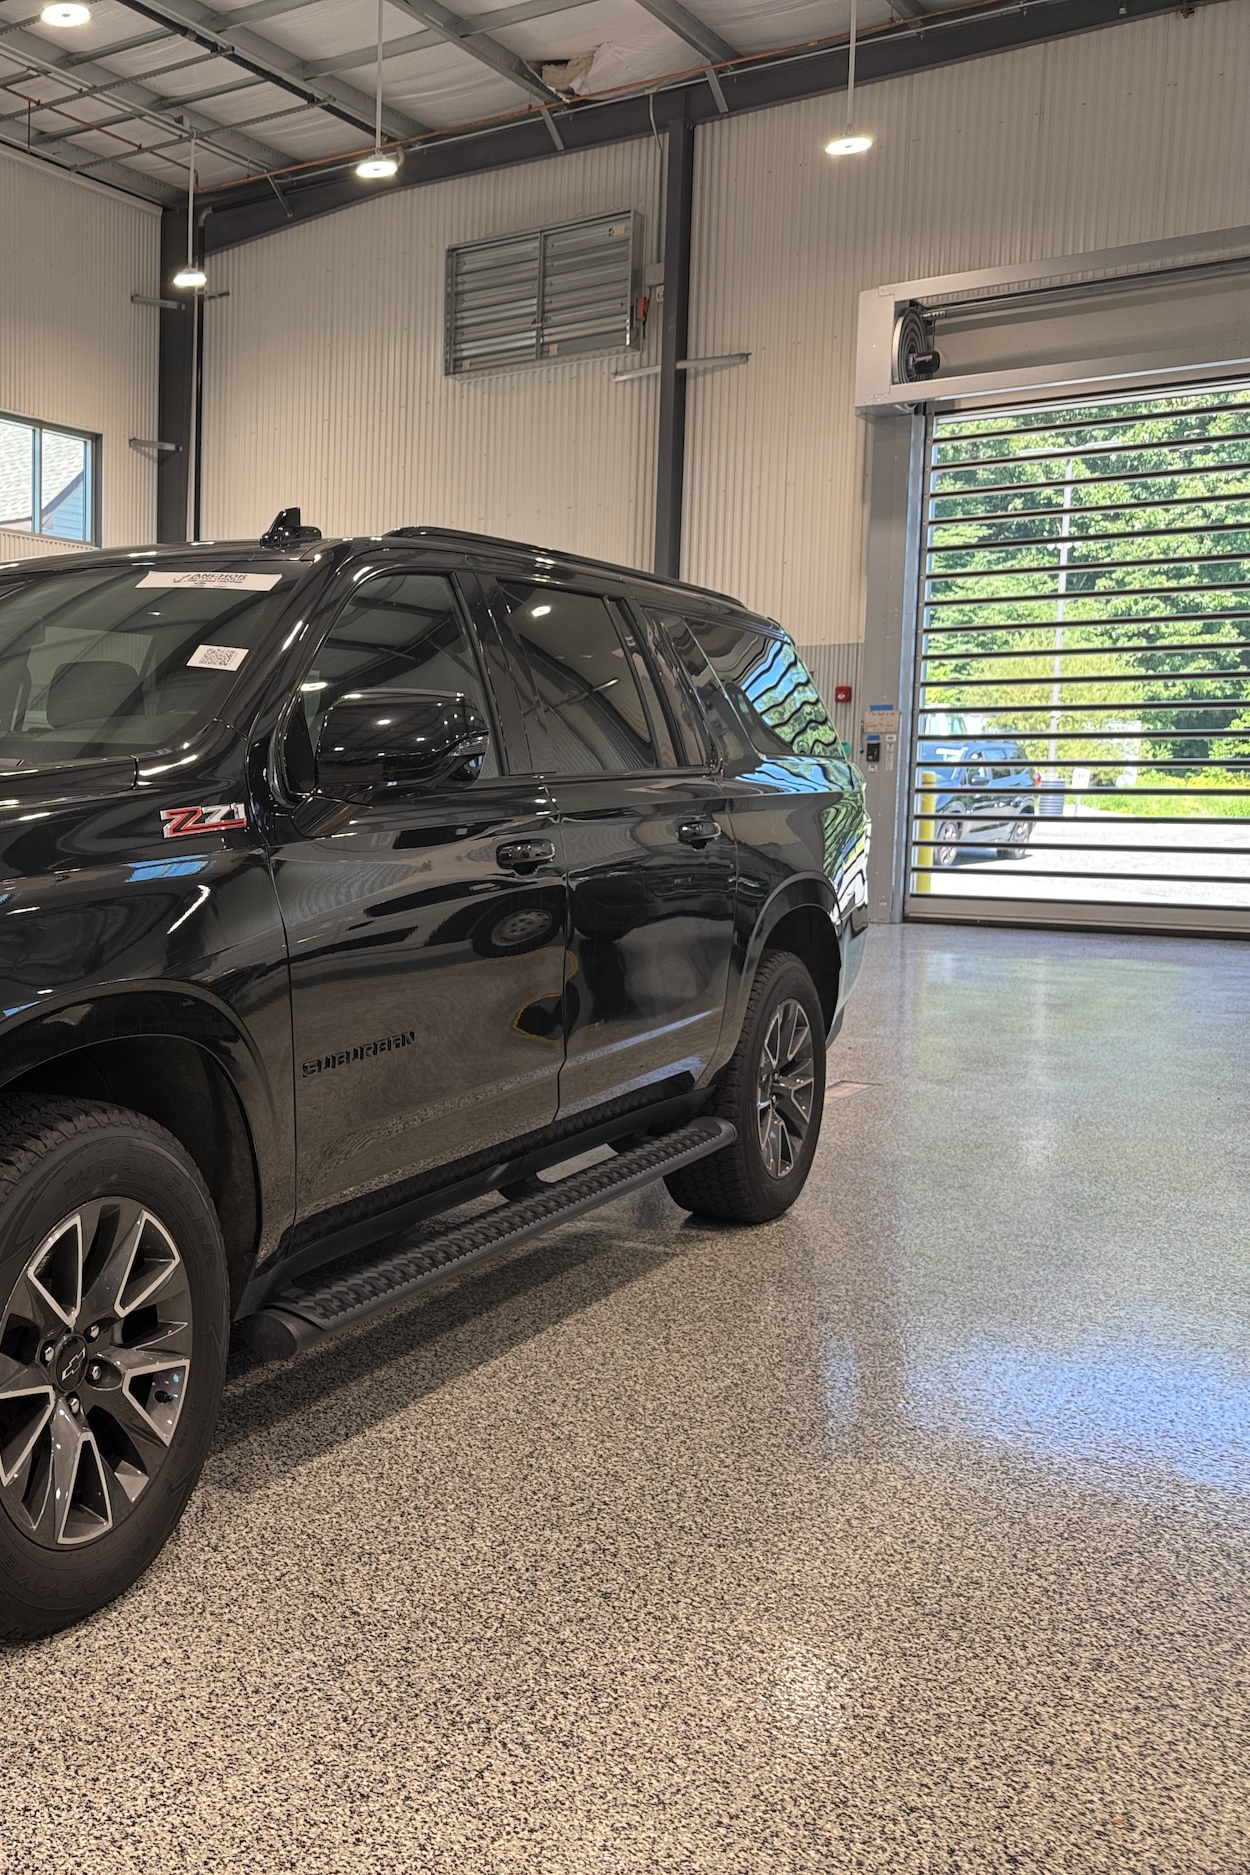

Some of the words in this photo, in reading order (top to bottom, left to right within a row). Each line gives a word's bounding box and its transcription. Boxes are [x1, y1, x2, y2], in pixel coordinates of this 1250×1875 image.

[160, 802, 247, 839] Z71
[302, 1030, 415, 1078] SUBURBAN
[63, 1154, 218, 1272] WRANGLER
